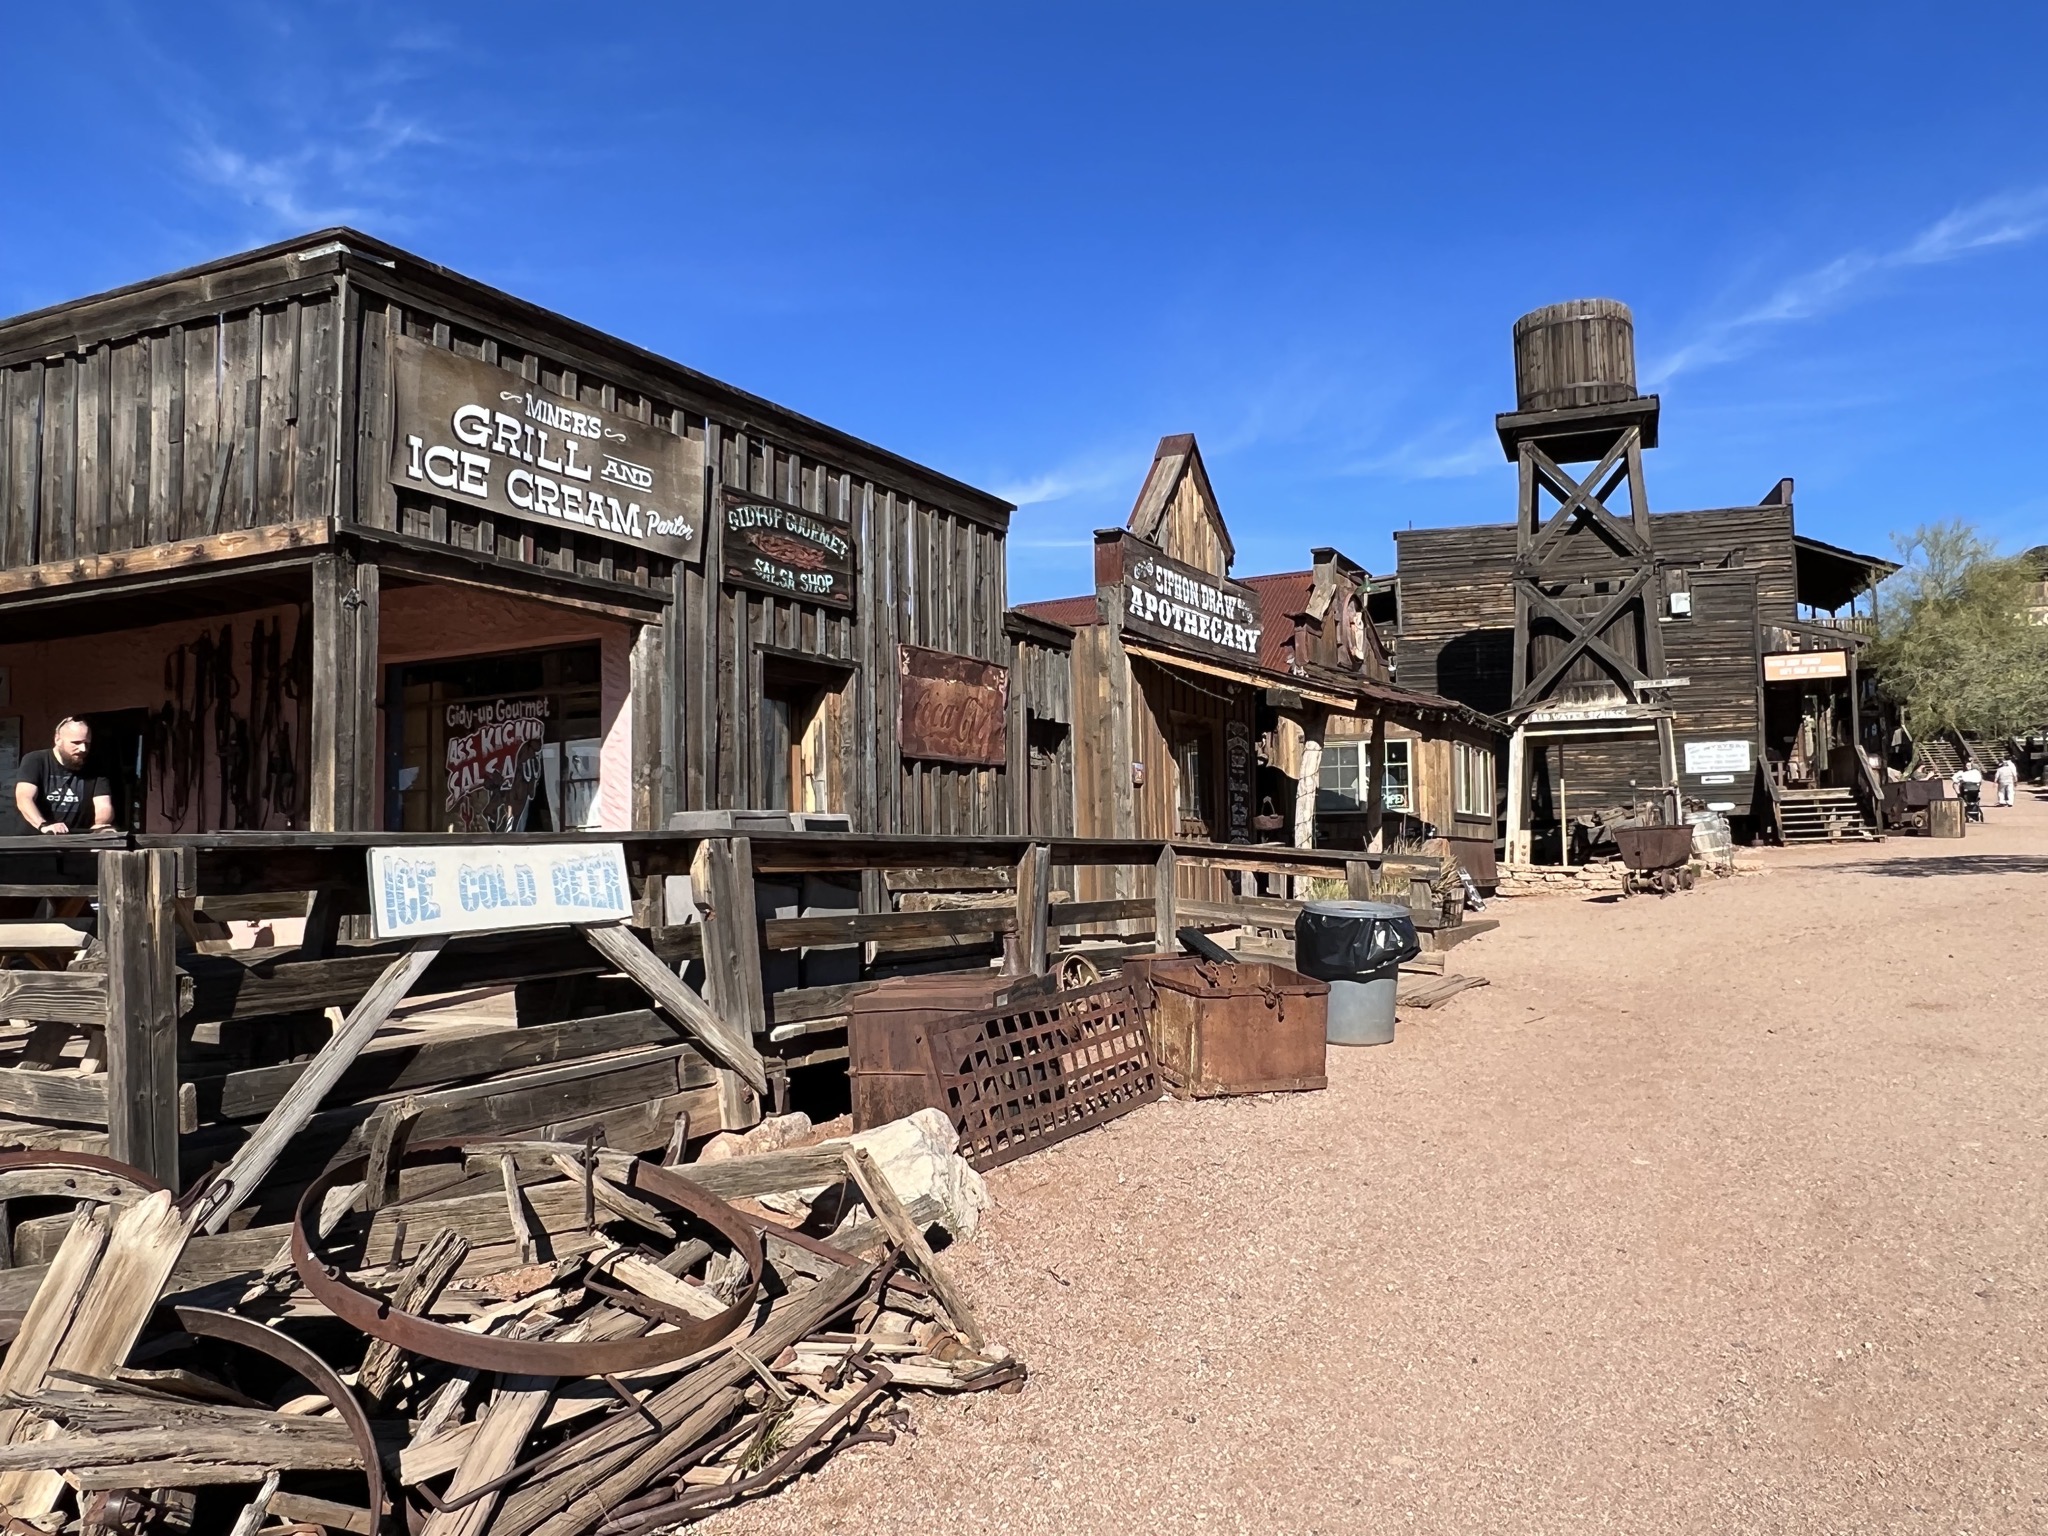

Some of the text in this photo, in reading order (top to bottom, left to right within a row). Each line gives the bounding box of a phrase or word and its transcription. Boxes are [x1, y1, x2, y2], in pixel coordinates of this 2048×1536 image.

[453, 404, 653, 488] GRILL AND
[406, 433, 695, 542] ICE CREAM Parlor
[752, 558, 834, 594] SALSA SHOP
[1155, 565, 1200, 608] SIPHON
[1129, 585, 1262, 653] APOTHECARY
[446, 696, 550, 729] Gidy-up Gourmet
[449, 738, 477, 766] ASS
[383, 849, 625, 930] ICE COLD BEER
